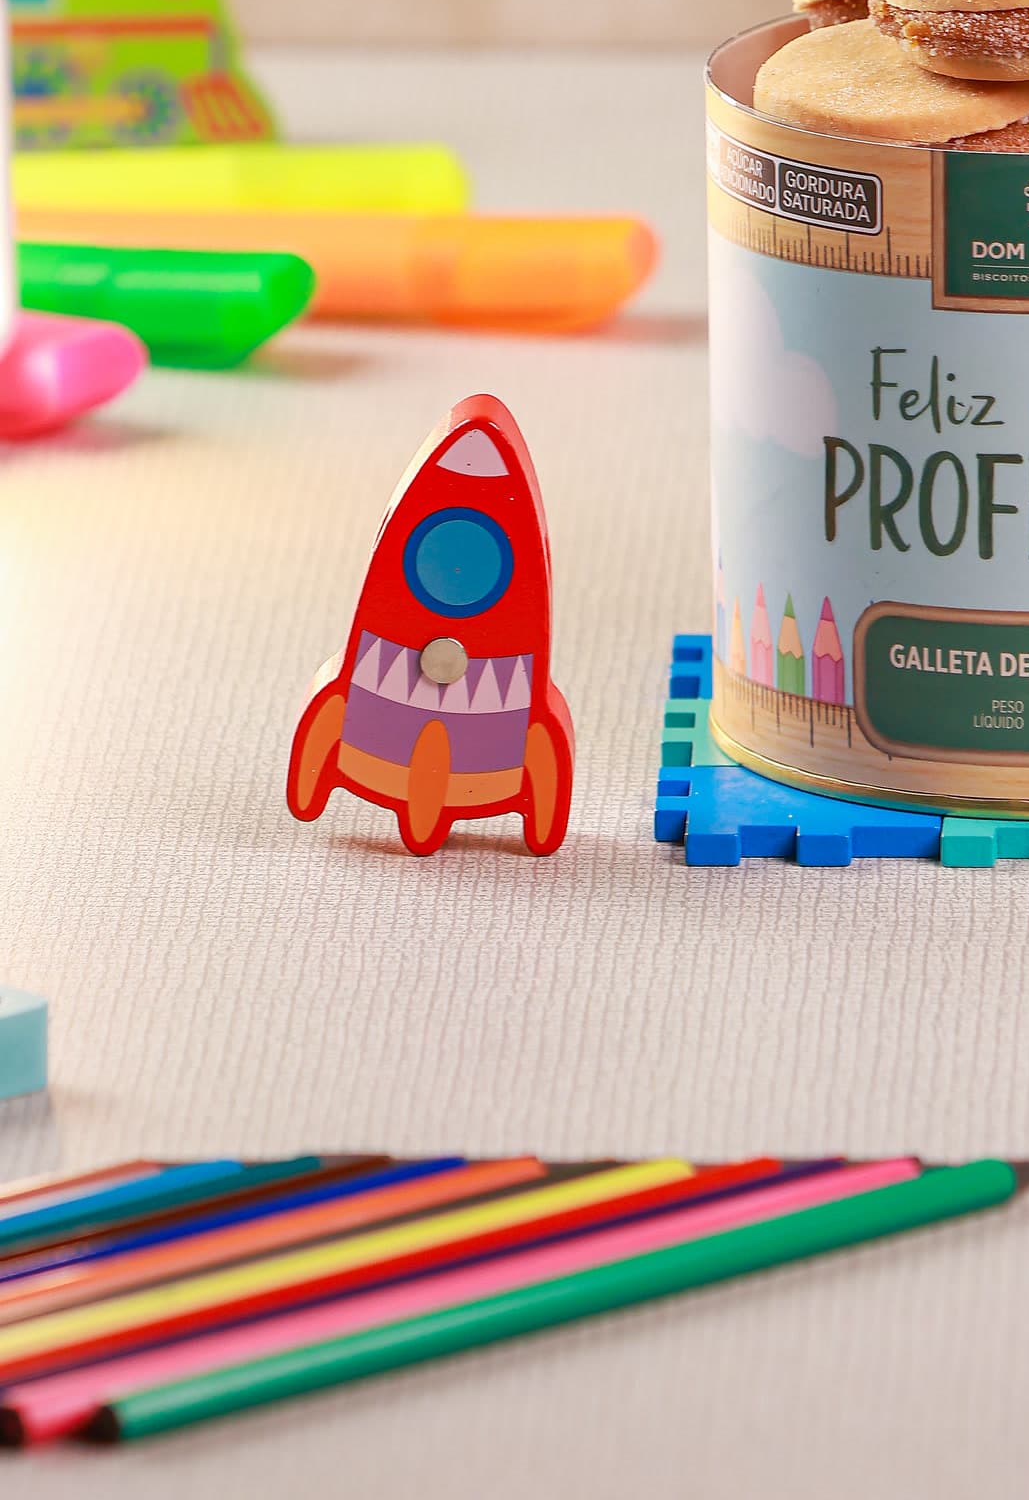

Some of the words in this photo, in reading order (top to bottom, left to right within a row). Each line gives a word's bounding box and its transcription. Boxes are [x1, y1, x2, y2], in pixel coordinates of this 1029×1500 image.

[785, 170, 867, 202] GORDURA
[782, 189, 871, 223] SATURADA
[971, 241, 1025, 260] DOM
[870, 346, 1005, 433] Feliz
[889, 643, 993, 676] GALLETA
[973, 713, 1025, 730] LÍQUIDO
[991, 700, 1025, 714] PESO
